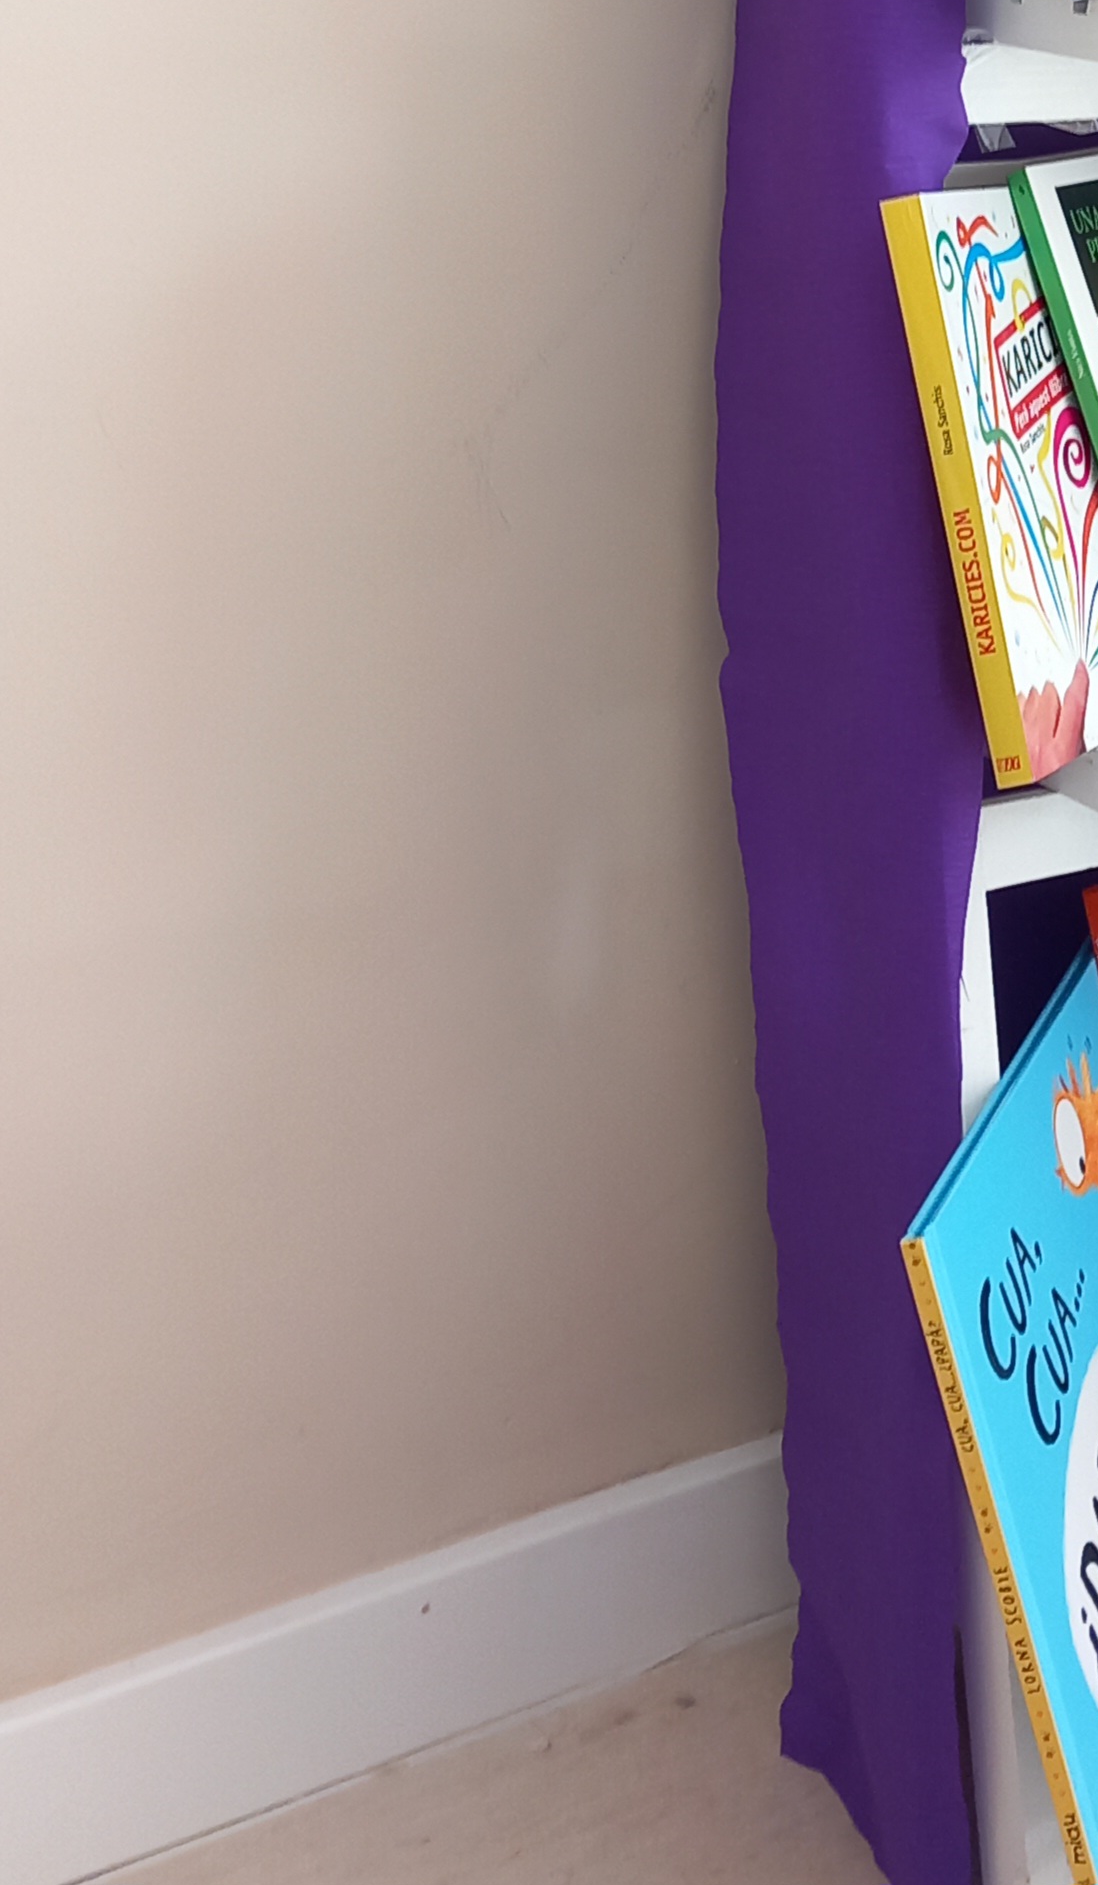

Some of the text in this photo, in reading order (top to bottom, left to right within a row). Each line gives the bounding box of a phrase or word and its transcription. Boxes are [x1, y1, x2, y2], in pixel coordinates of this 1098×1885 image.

[953, 508, 996, 655] KARICIES.COM
[980, 1227, 1042, 1381] CUA,
[1026, 1268, 1085, 1446] CUA...
